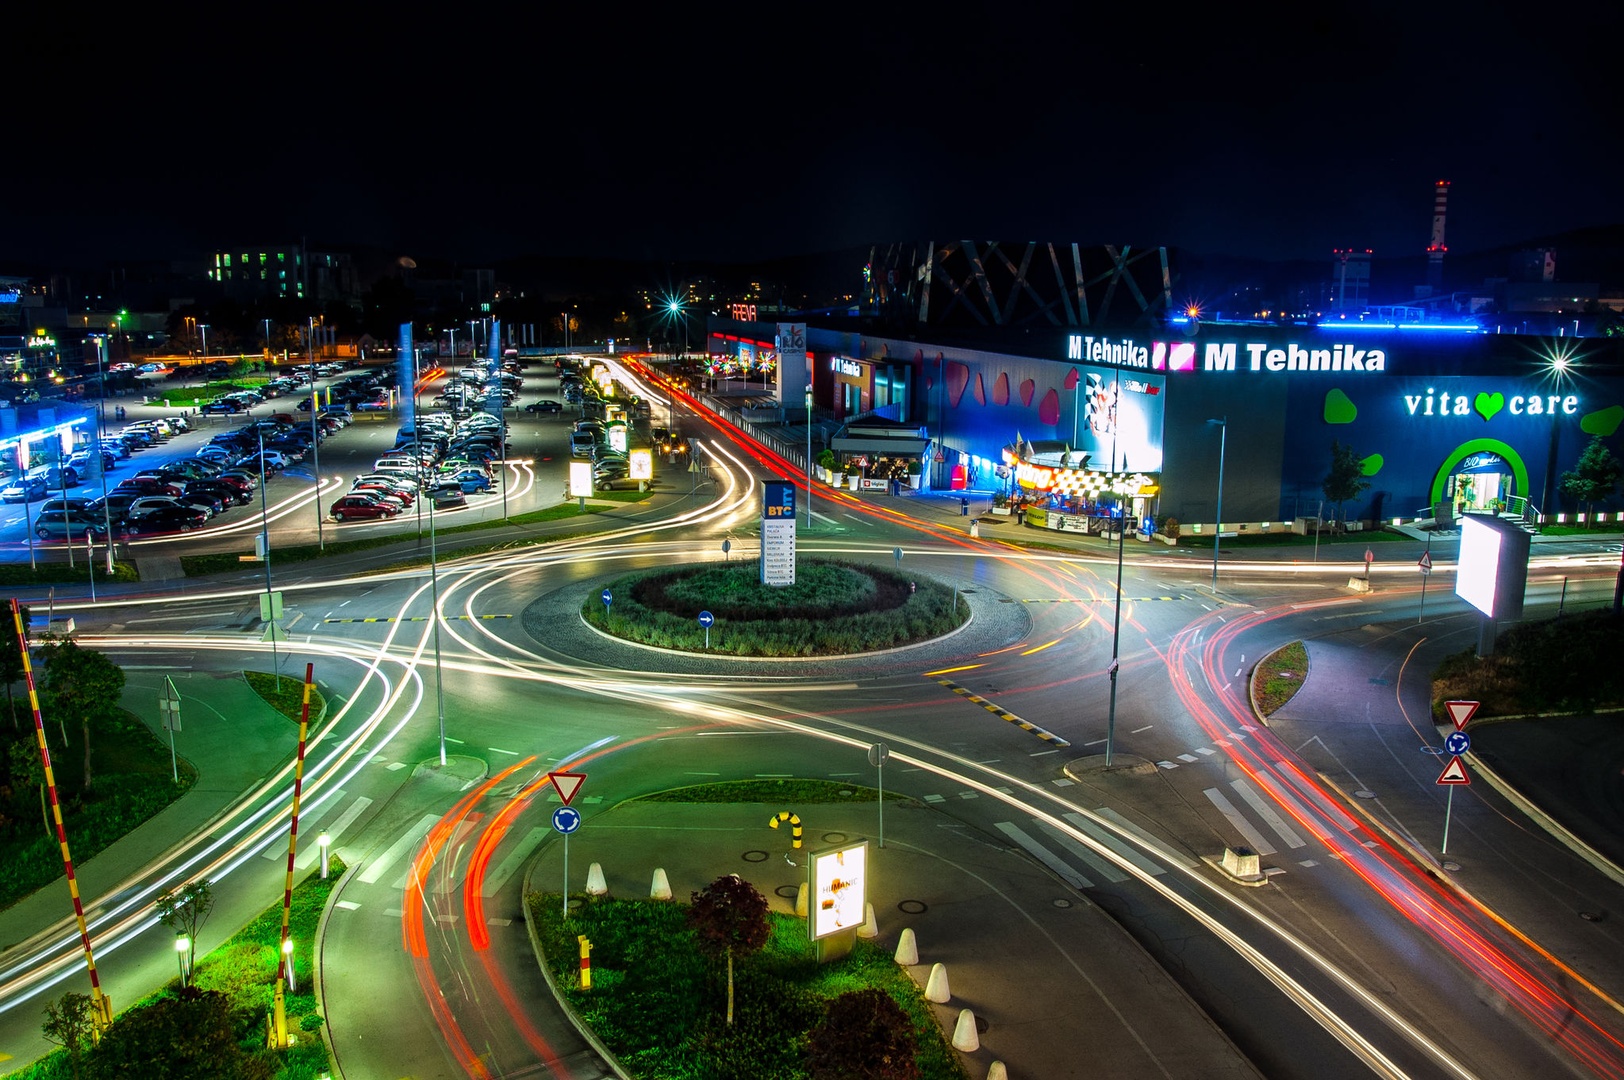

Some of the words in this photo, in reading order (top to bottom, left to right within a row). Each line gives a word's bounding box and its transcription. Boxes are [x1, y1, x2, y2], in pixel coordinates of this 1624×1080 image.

[733, 304, 756, 321] ARENA
[782, 335, 805, 348] RIO
[1069, 335, 1082, 359] M
[1085, 336, 1148, 368] Tehnika
[1204, 343, 1237, 371] M
[1247, 343, 1385, 371] Tehnika
[1404, 388, 1471, 416] vita
[1509, 395, 1578, 415] care
[1464, 457, 1479, 467] BIO
[768, 506, 792, 516] BTC
[822, 878, 858, 894] HUMANIC
